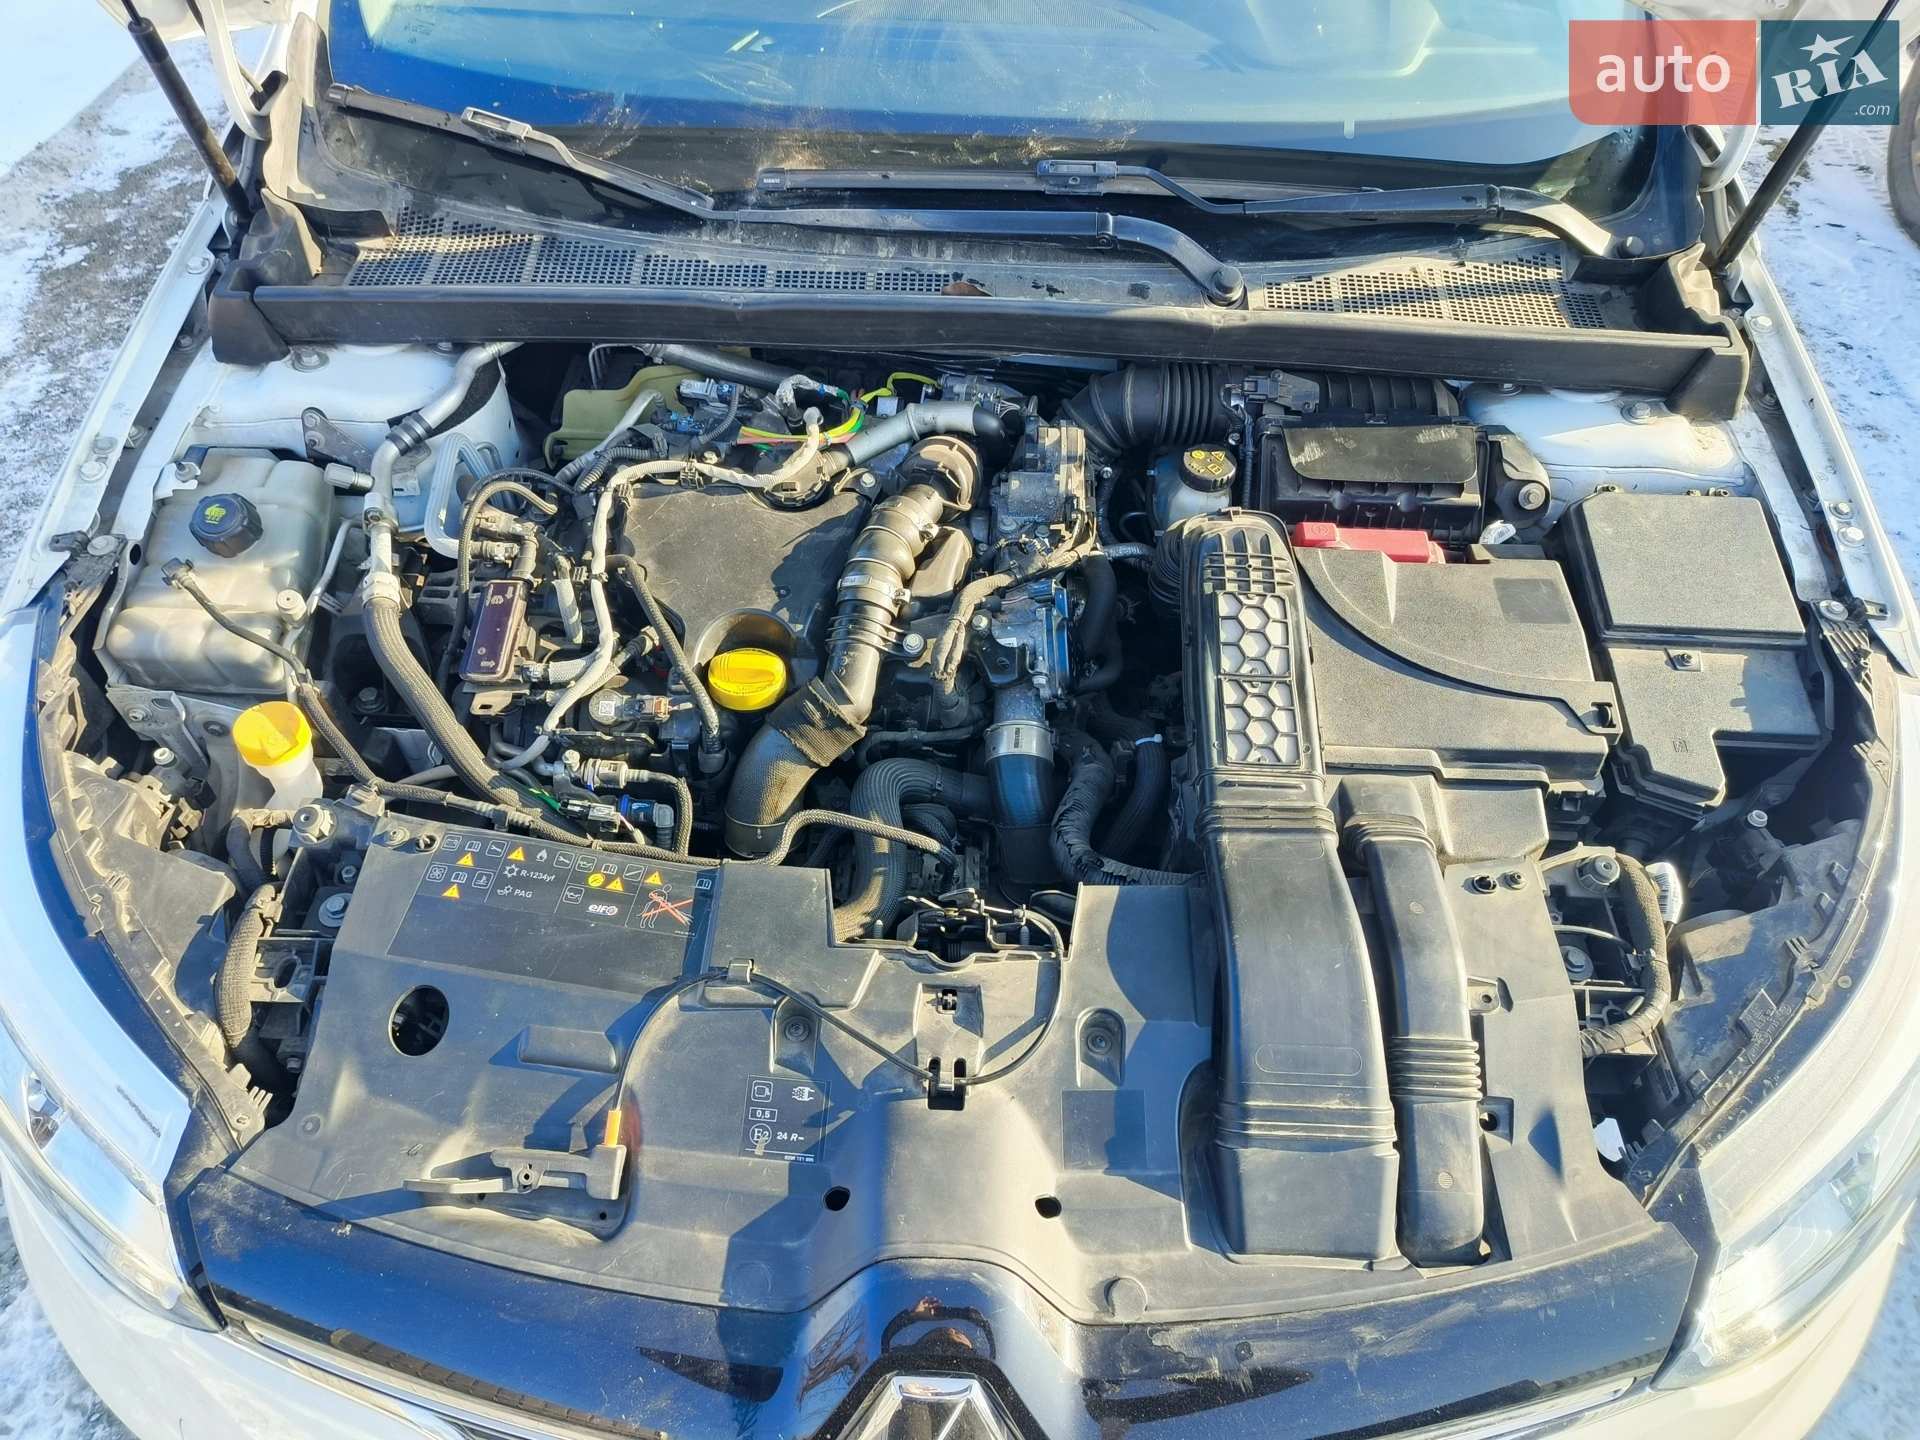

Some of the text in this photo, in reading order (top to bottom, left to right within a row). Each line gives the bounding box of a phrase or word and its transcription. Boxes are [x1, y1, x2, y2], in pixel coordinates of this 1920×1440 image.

[520, 869, 556, 882] R-1234yf
[513, 888, 533, 898] PAG
[756, 1109, 771, 1119] 0,5
[753, 1128, 769, 1141] E2
[776, 1131, 788, 1141] 24
